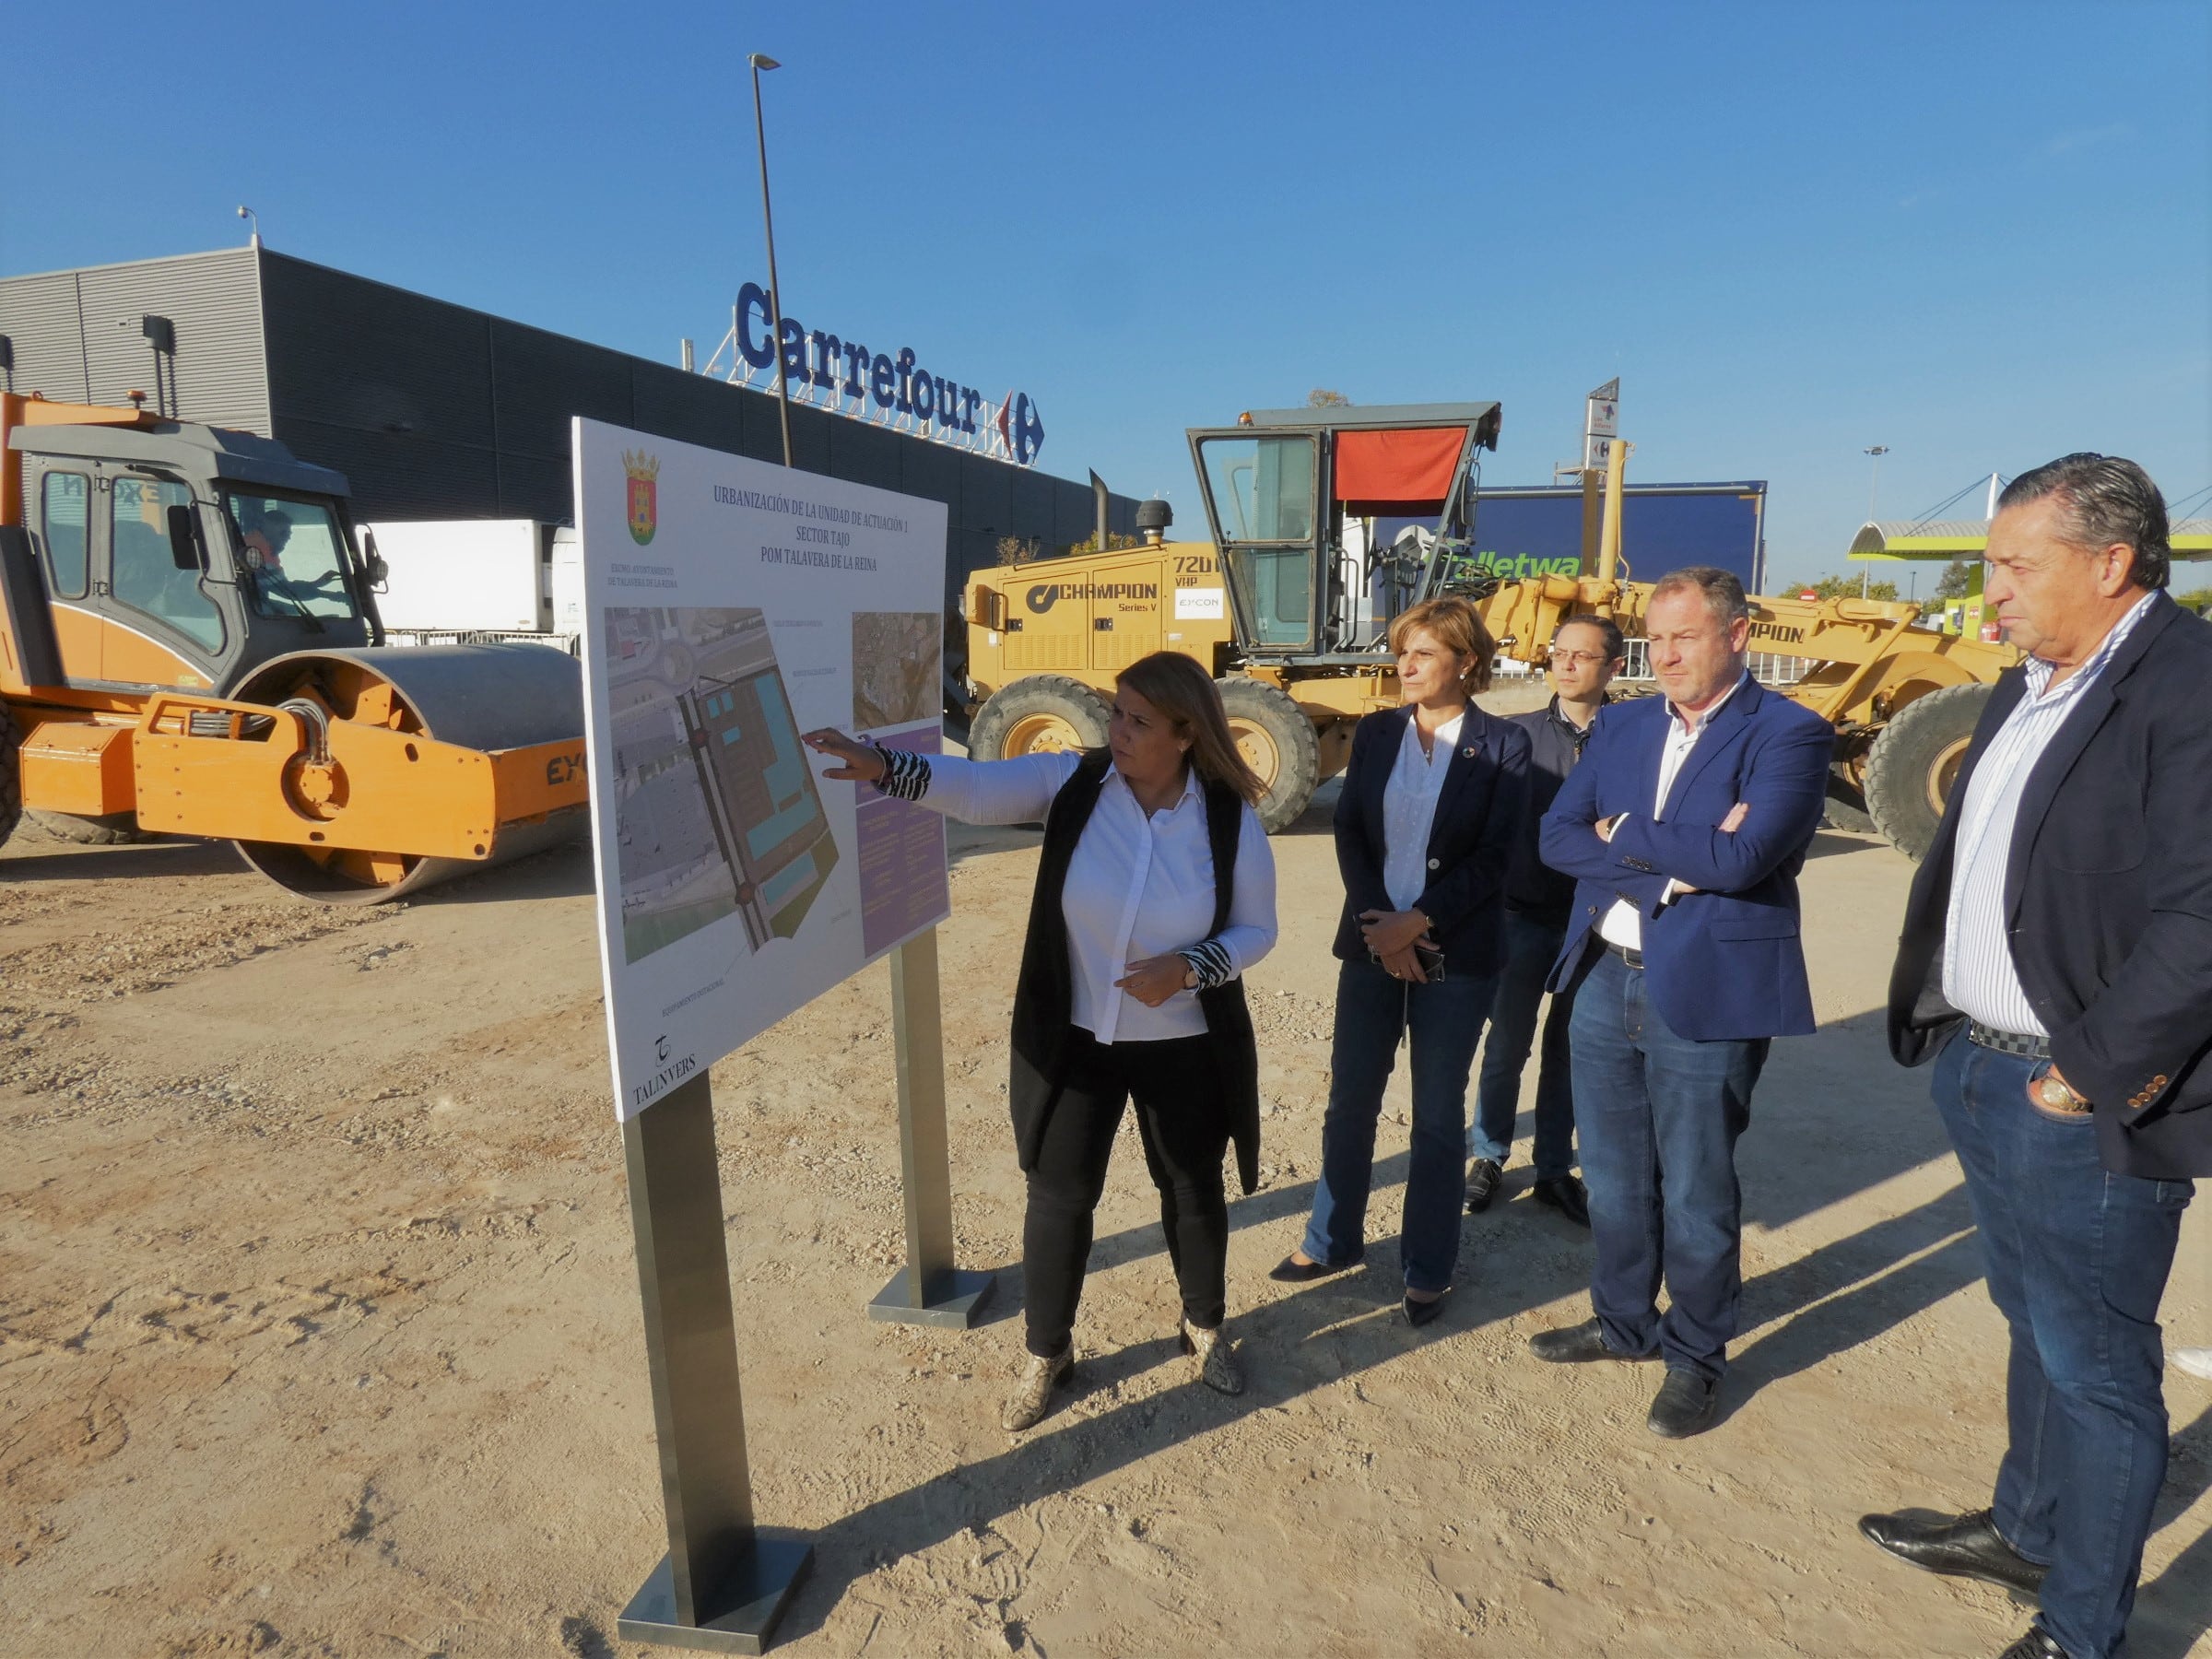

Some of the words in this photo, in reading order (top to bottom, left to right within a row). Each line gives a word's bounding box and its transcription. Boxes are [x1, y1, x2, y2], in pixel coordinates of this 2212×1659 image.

[737, 282, 981, 434] Carrefour
[713, 485, 790, 515] URBANIZACIÓN
[792, 500, 804, 516] DE
[806, 502, 818, 519] LA
[818, 504, 850, 524] UNIDAD
[852, 511, 863, 526] DE
[863, 513, 903, 533] ACTUACIÓN
[796, 525, 830, 545] SECTOR
[830, 531, 850, 549] TAJO
[760, 547, 782, 563] POM
[783, 548, 830, 569] TALAVERA
[830, 554, 842, 569] DE
[843, 555, 853, 571] LA
[854, 556, 877, 571] REINA
[1173, 556, 1220, 573] 720
[1060, 583, 1158, 600] CHAMPION
[1175, 577, 1198, 587] VHP
[1118, 603, 1148, 612] Series
[1150, 603, 1158, 612] V
[547, 752, 588, 786] EX
